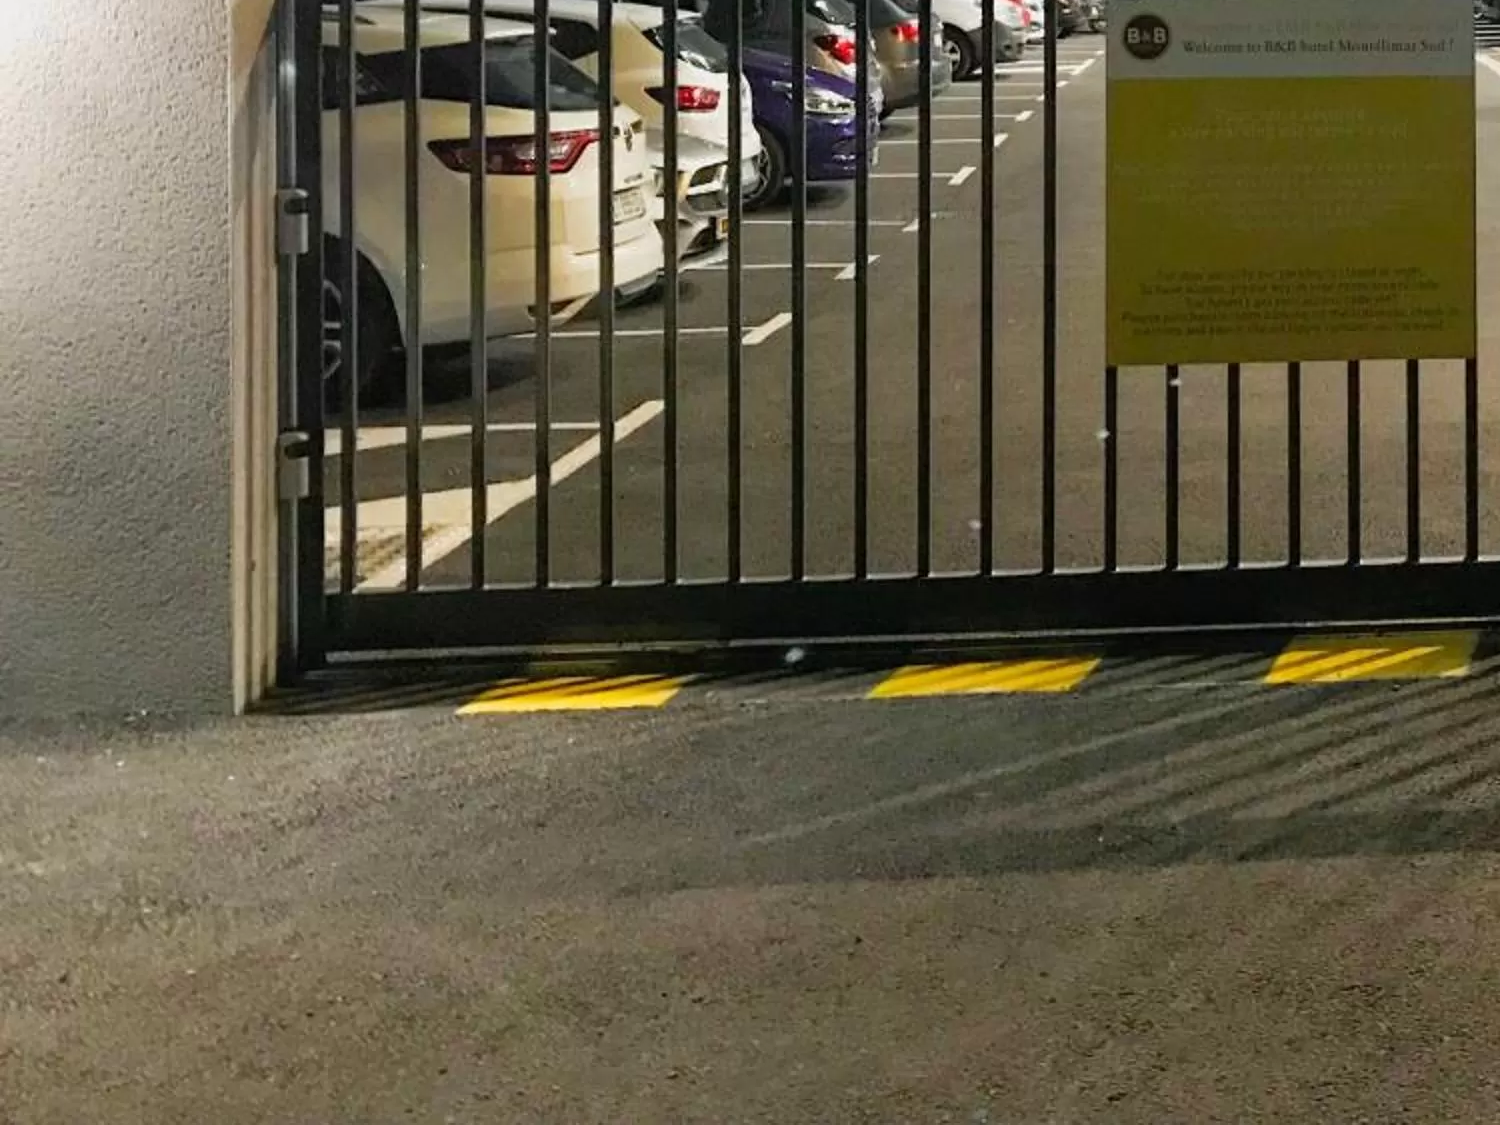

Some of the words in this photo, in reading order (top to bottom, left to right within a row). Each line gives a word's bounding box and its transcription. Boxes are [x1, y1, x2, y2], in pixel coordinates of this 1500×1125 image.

[1182, 39, 1242, 54] Welcome
[1247, 40, 1261, 53] to
[1264, 39, 1297, 53] B&B
